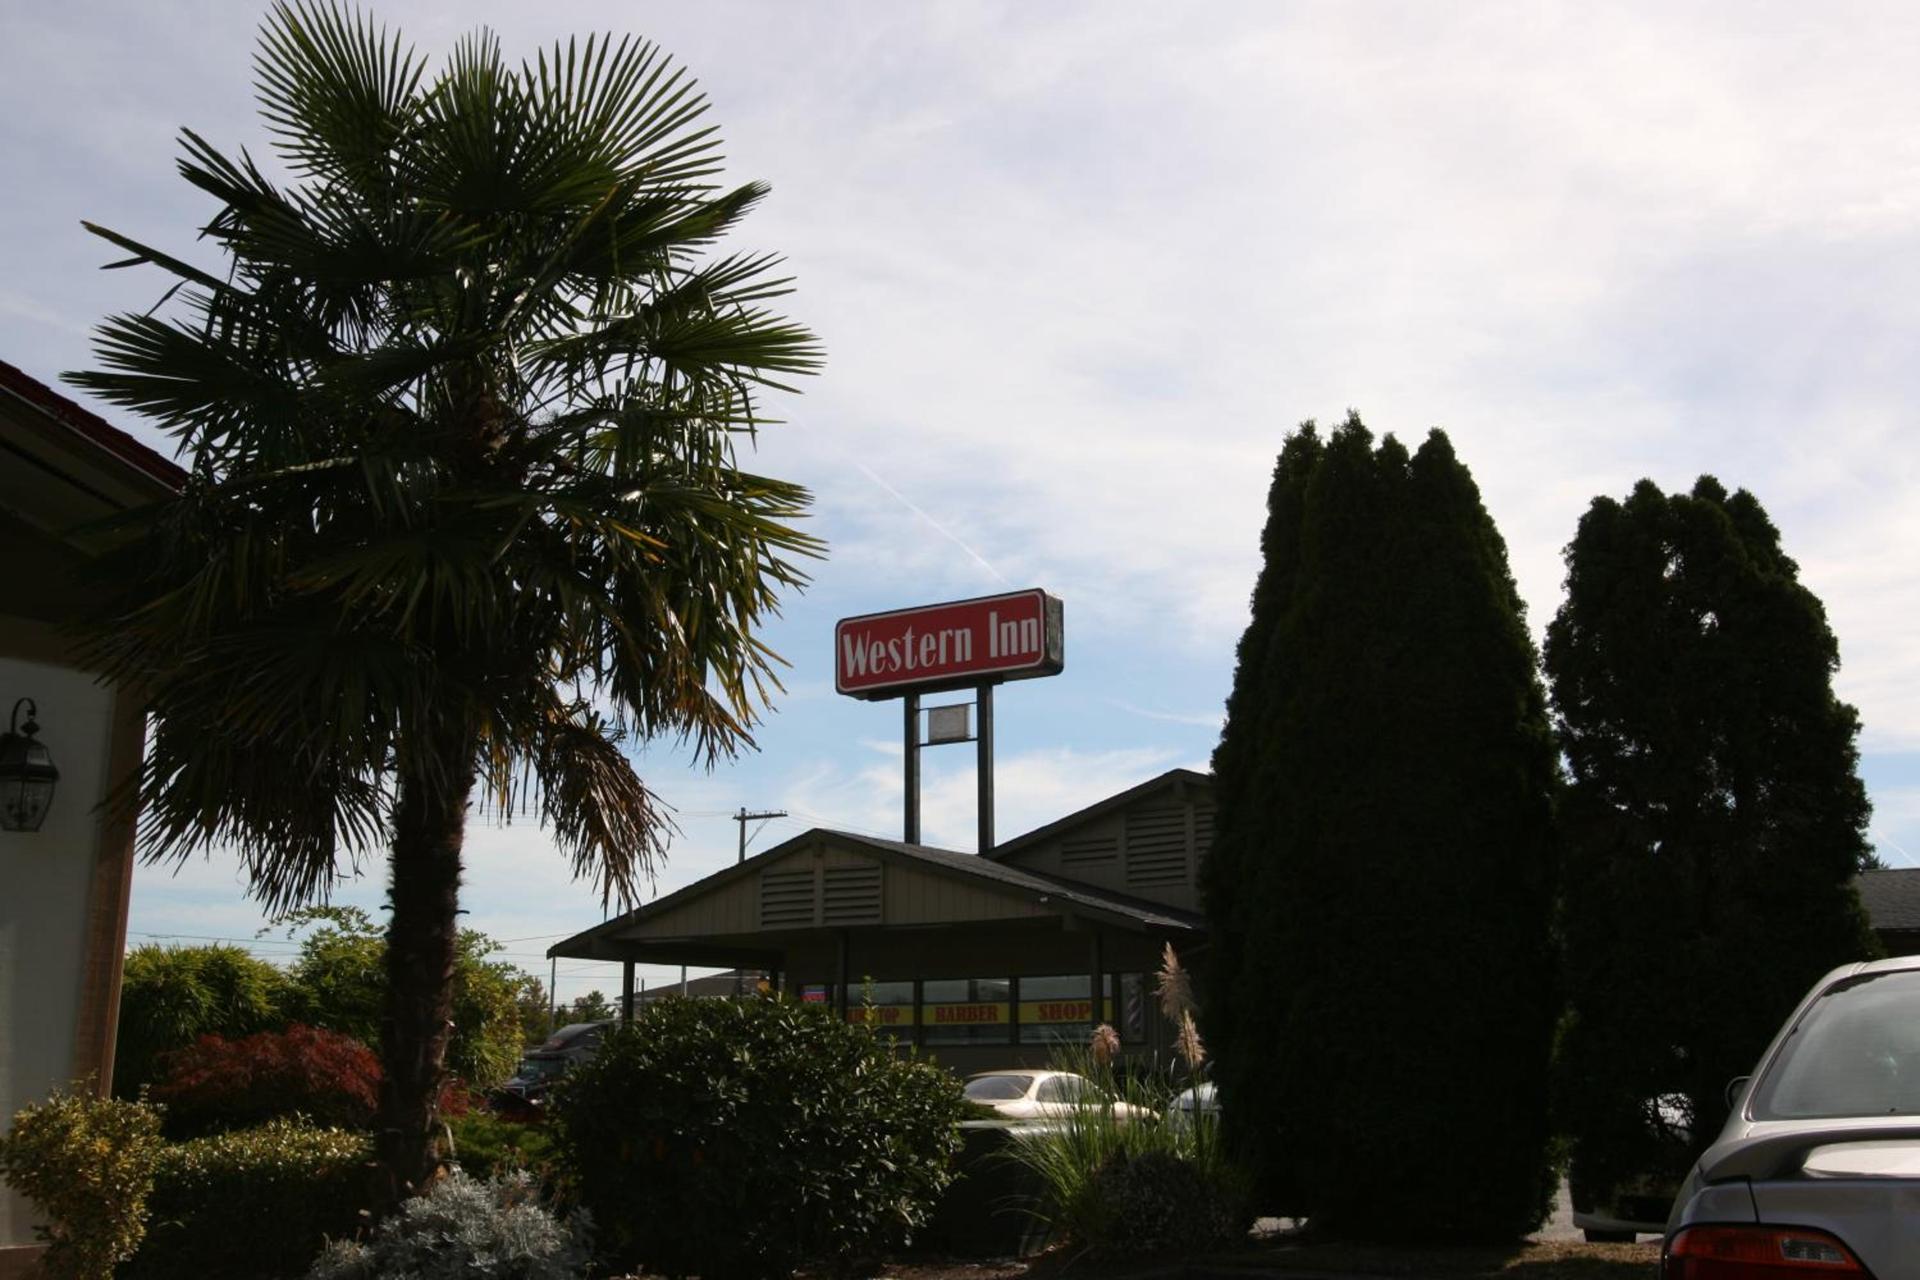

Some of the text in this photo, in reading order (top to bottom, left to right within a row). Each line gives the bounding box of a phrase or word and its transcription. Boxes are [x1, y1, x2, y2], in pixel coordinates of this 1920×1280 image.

[842, 611, 1039, 678] Western Inn
[935, 1005, 998, 1023] BARBER
[1038, 1003, 1091, 1021] SHOP
